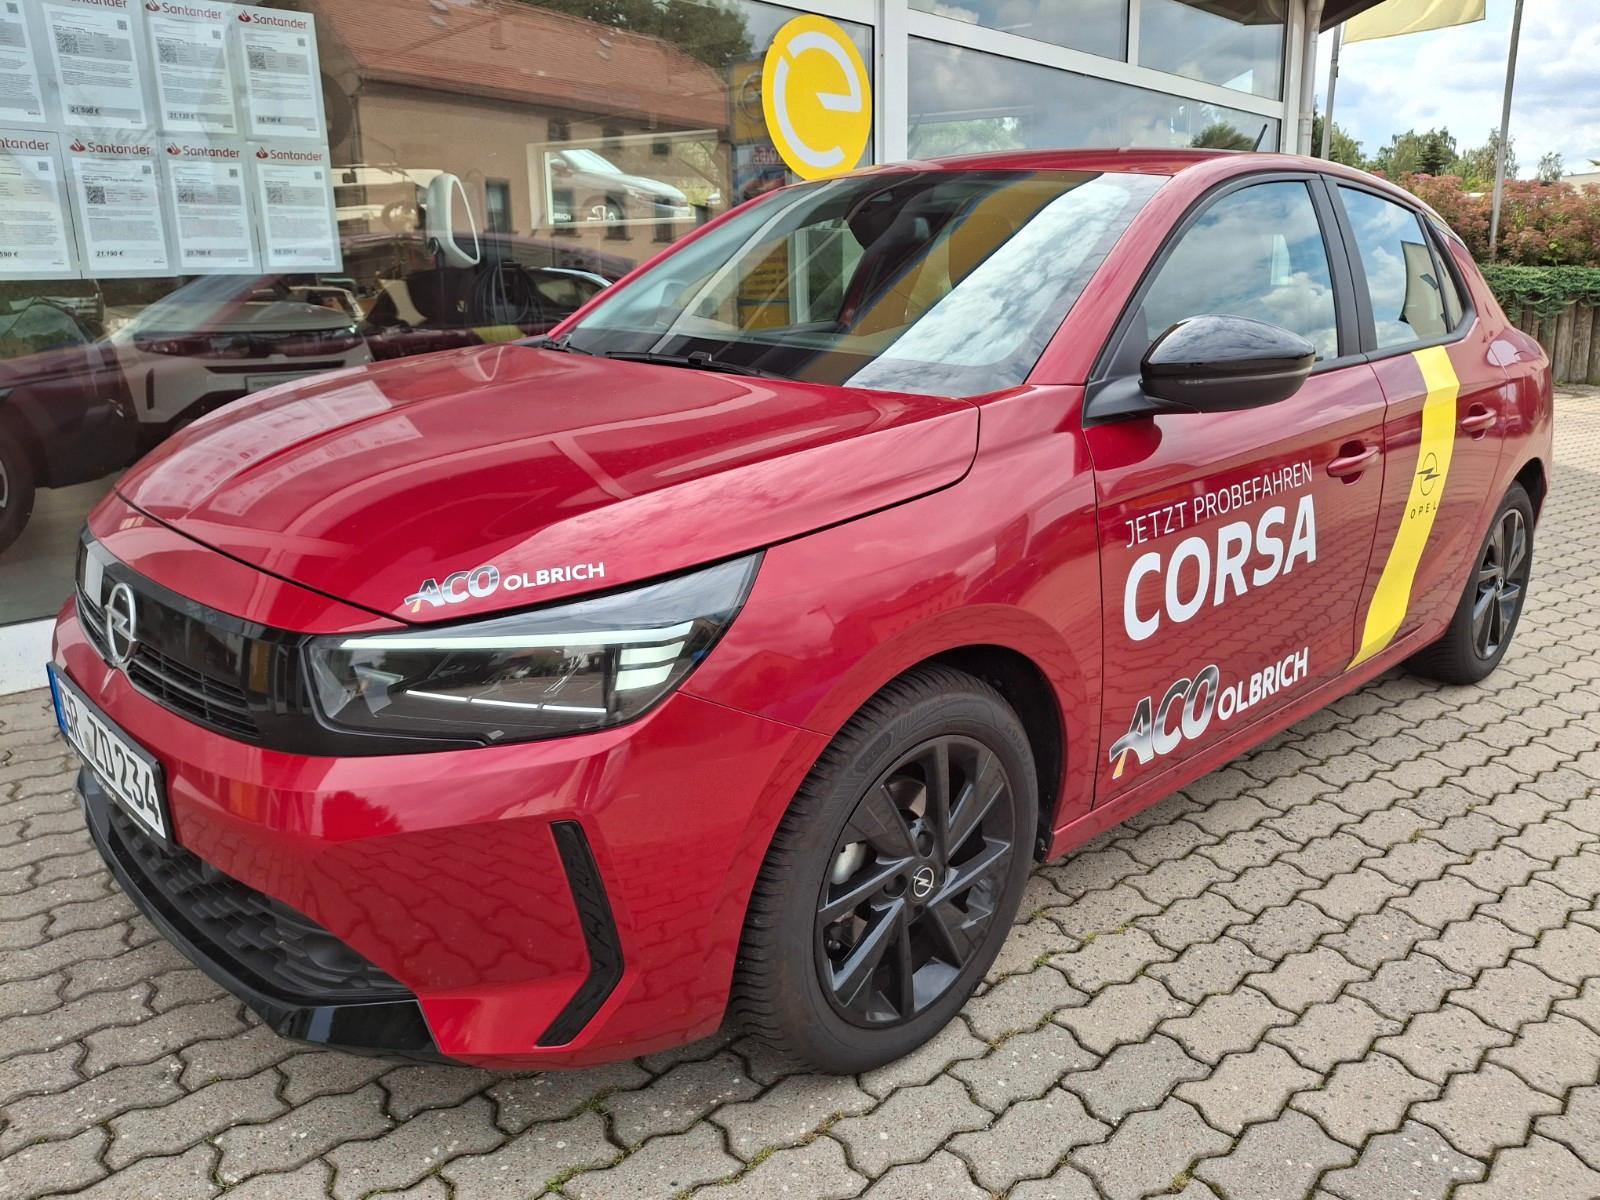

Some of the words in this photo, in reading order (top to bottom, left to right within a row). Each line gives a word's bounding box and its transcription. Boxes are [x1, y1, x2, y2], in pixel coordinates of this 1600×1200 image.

[162, 2, 222, 20] Santander
[252, 13, 307, 29] Santander
[0, 138, 50, 151] ntander
[88, 142, 150, 156] Santander
[182, 145, 240, 158] Santander
[270, 150, 323, 161] Santander
[1125, 501, 1187, 548] JETZT
[1194, 460, 1313, 523] PROBEFAHREN
[1410, 501, 1437, 519] OPEL
[1123, 494, 1316, 641] CORSA
[404, 565, 500, 613] ACO
[503, 562, 605, 591] OLBRICH
[1109, 664, 1219, 779] ACO
[1217, 647, 1309, 720] OLBRICH
